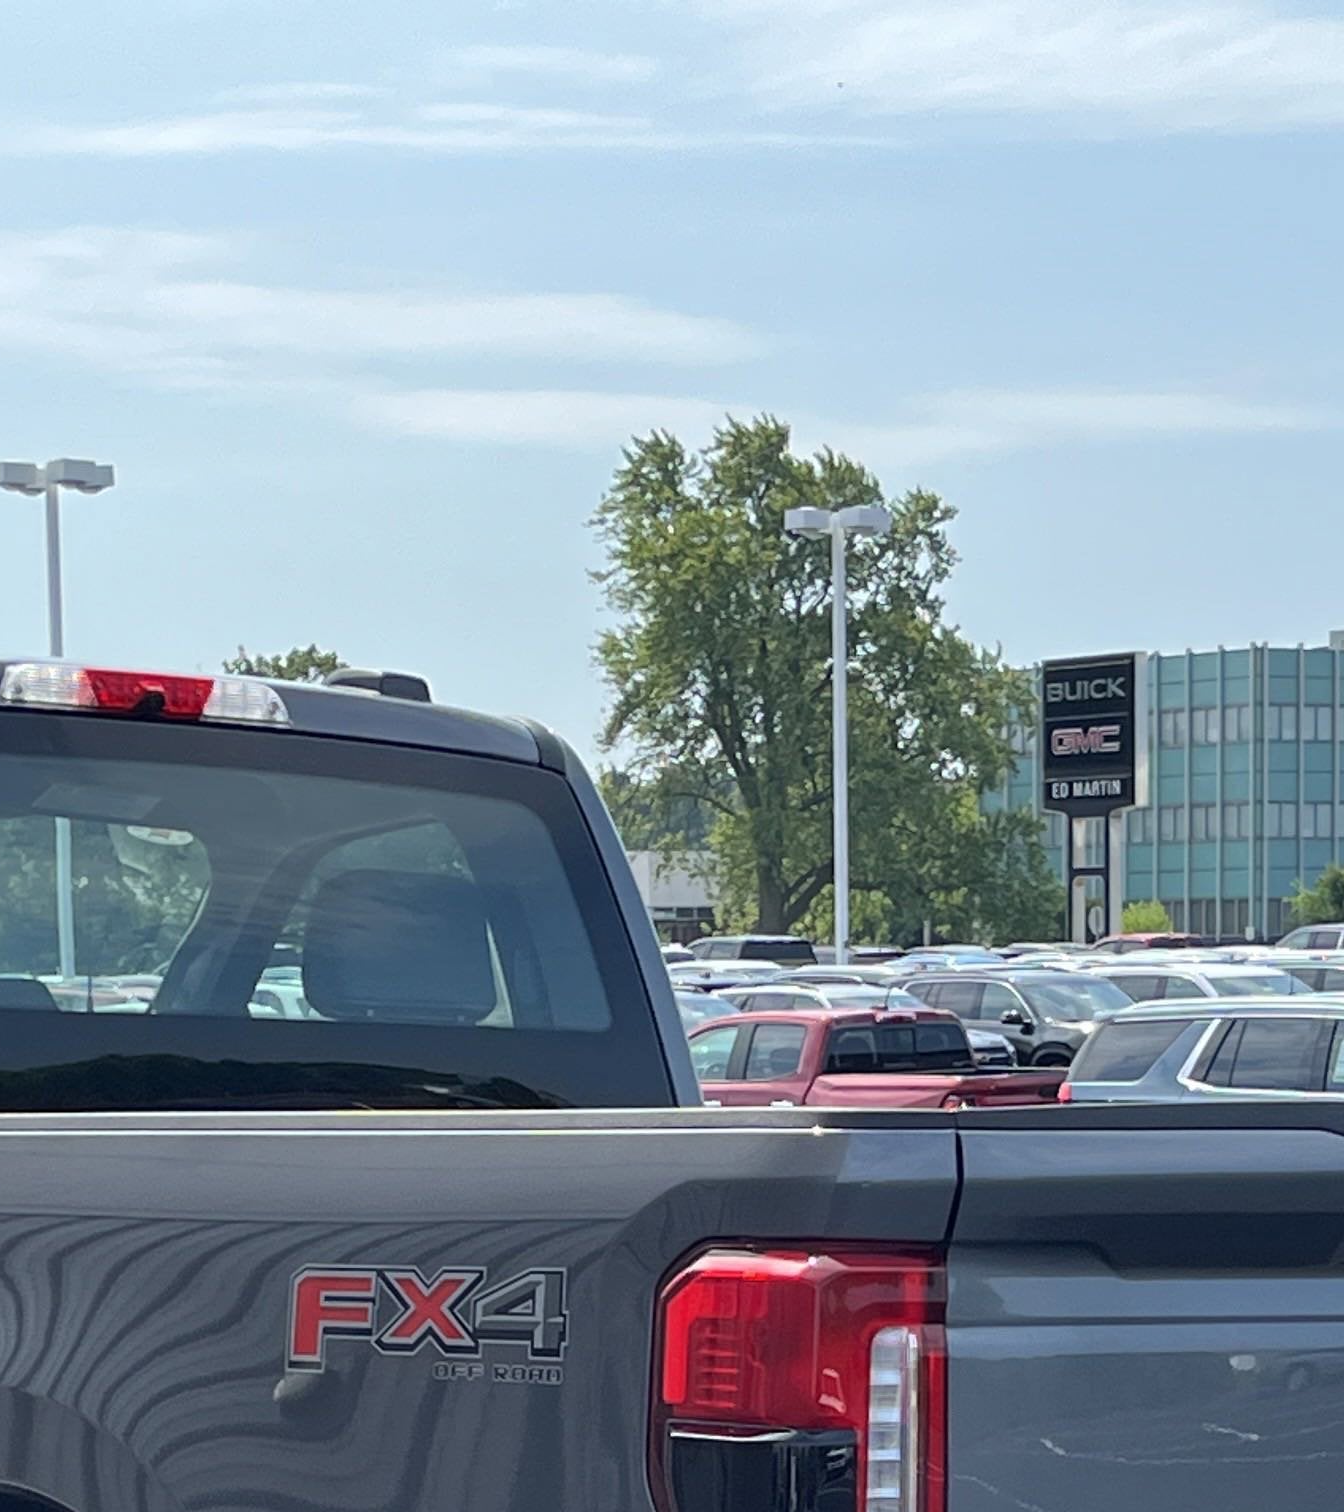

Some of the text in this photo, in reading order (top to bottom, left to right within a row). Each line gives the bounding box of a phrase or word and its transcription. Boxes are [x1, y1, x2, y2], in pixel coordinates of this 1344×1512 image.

[1046, 677, 1125, 702] BUICK
[1051, 724, 1120, 755] GMC
[1052, 779, 1121, 799] ED MARTIN
[285, 1263, 569, 1373] FX4
[433, 1360, 565, 1385] OFF ROAD
